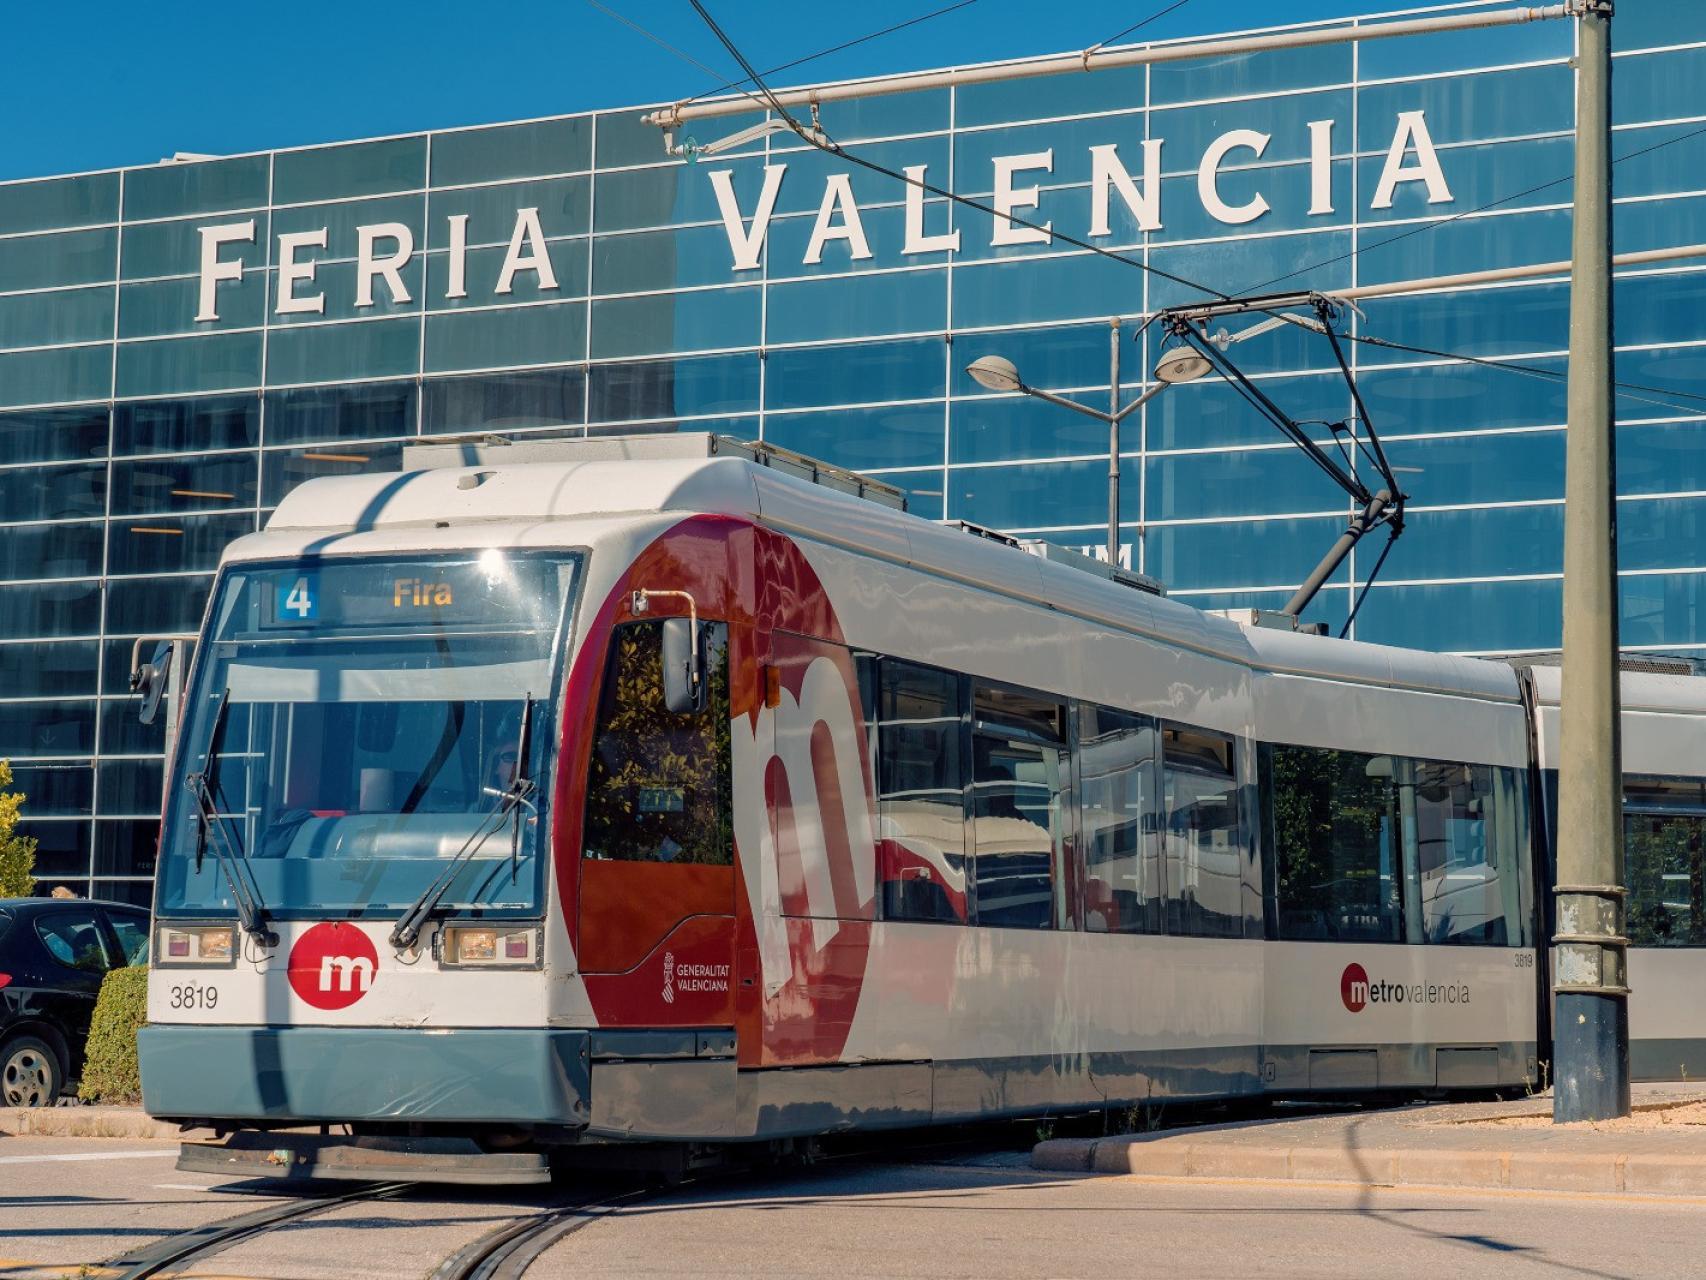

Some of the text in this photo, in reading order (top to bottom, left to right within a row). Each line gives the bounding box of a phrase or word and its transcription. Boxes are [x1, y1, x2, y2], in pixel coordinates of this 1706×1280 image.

[194, 110, 1454, 322] FERIA VALENCIA
[285, 577, 312, 616] 4
[394, 578, 451, 608] Fira
[677, 965, 730, 977] GENERALITAT
[1514, 954, 1533, 967] 3819
[319, 955, 374, 992] m
[677, 980, 729, 991] VALENCIANA
[171, 986, 218, 1009] 3819
[1351, 979, 1470, 1004] metrovalencia
